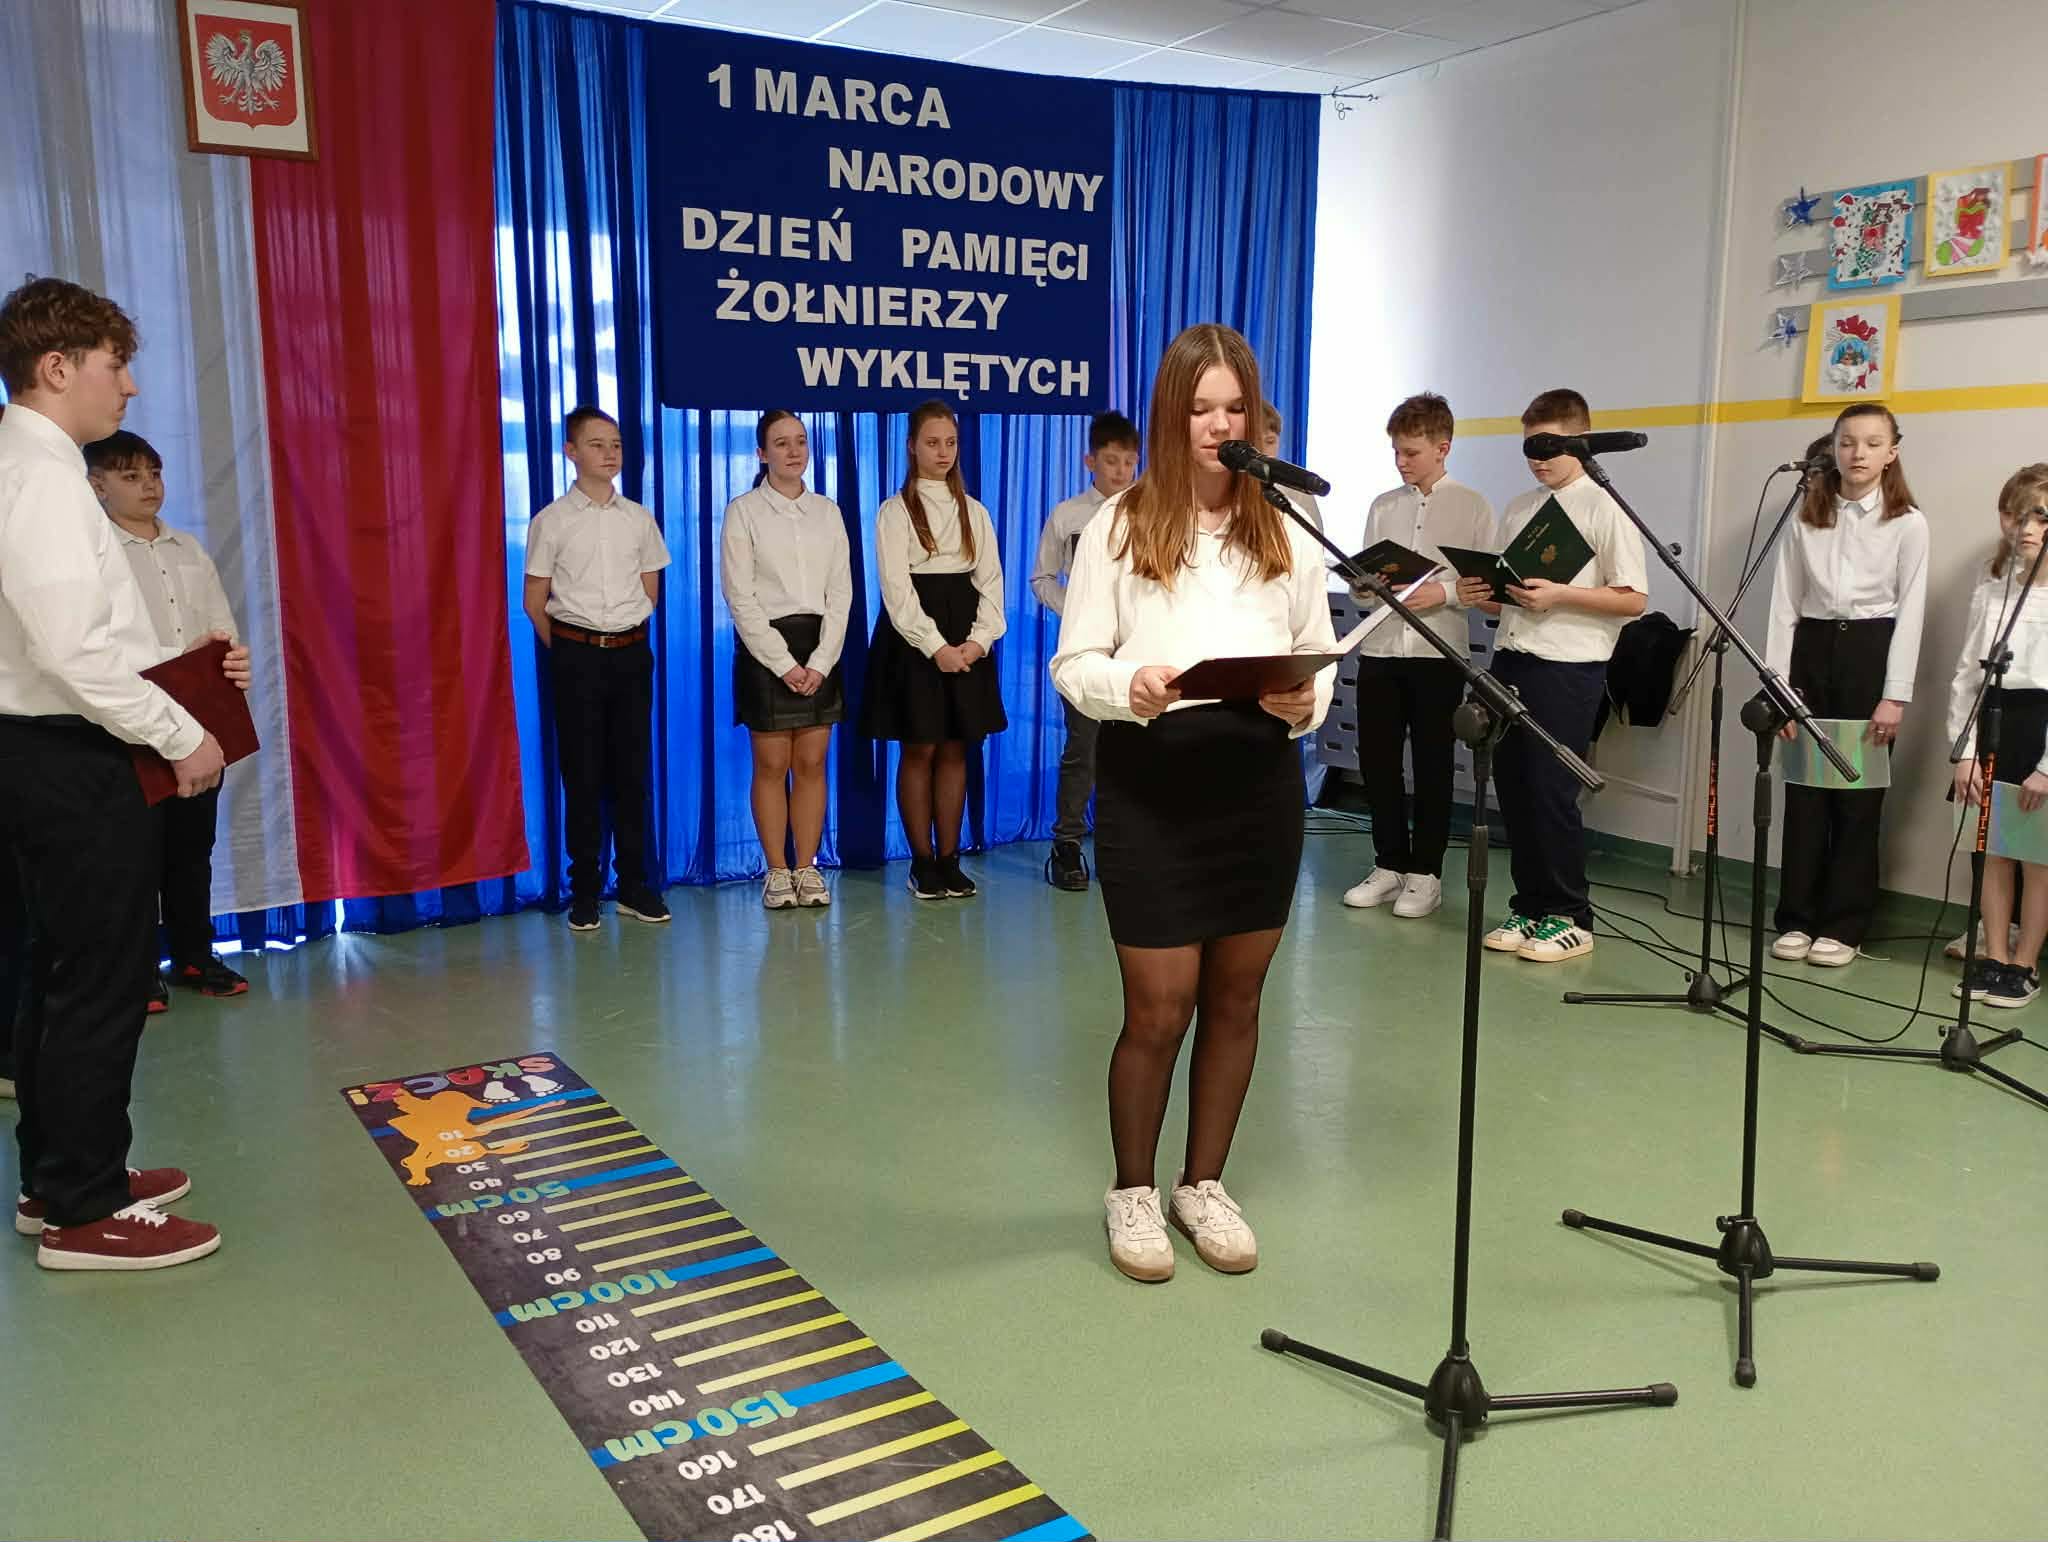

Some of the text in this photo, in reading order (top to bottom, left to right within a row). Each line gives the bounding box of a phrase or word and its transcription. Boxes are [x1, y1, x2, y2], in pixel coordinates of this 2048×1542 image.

[708, 63, 951, 129] 1 MARCA
[828, 147, 1104, 212] NARODOWY
[681, 206, 1089, 287] DZIEŃ PAMIĘCI
[715, 267, 1008, 331] ŻOŁNIERZY
[797, 347, 1090, 400] WYKLĘTYCH
[439, 1130, 464, 1141] 10
[445, 1145, 474, 1158] 20
[456, 1161, 490, 1175] 30
[469, 1177, 502, 1191] 40
[497, 1210, 531, 1225] 60
[512, 1228, 549, 1244] 70
[526, 1248, 563, 1264] 80
[544, 1268, 582, 1285] 90
[575, 1313, 620, 1333] 110
[589, 1336, 641, 1360] 120
[607, 1362, 663, 1387] 130
[628, 1389, 686, 1416] 140
[678, 1450, 738, 1480] 160
[706, 1483, 766, 1515] 170
